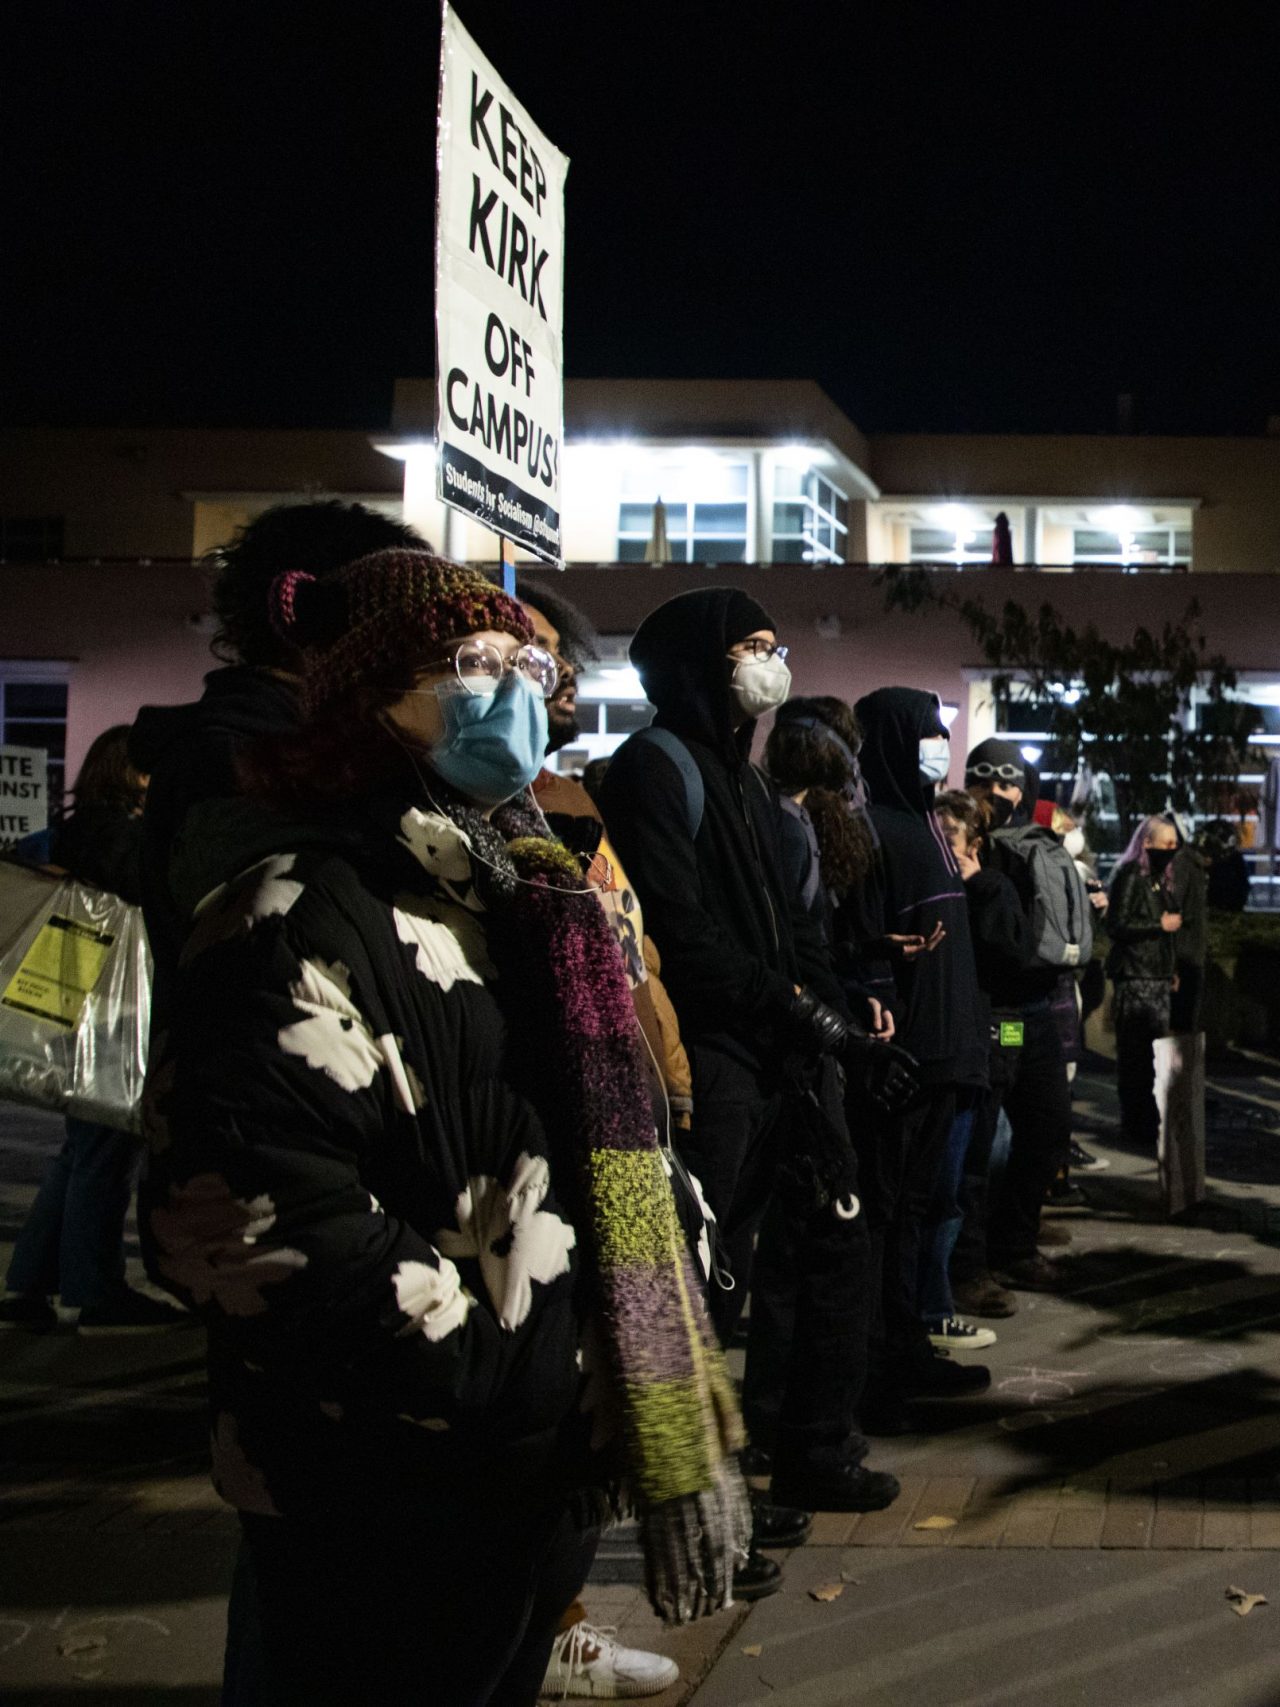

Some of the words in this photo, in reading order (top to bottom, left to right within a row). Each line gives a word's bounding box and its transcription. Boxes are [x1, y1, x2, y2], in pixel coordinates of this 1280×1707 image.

[470, 69, 547, 218] KEEP
[469, 172, 550, 322] KIRK
[485, 312, 535, 398] OFF
[446, 367, 558, 493] CAMPUS!
[445, 462, 485, 503] Students
[497, 492, 533, 530] Socialism
